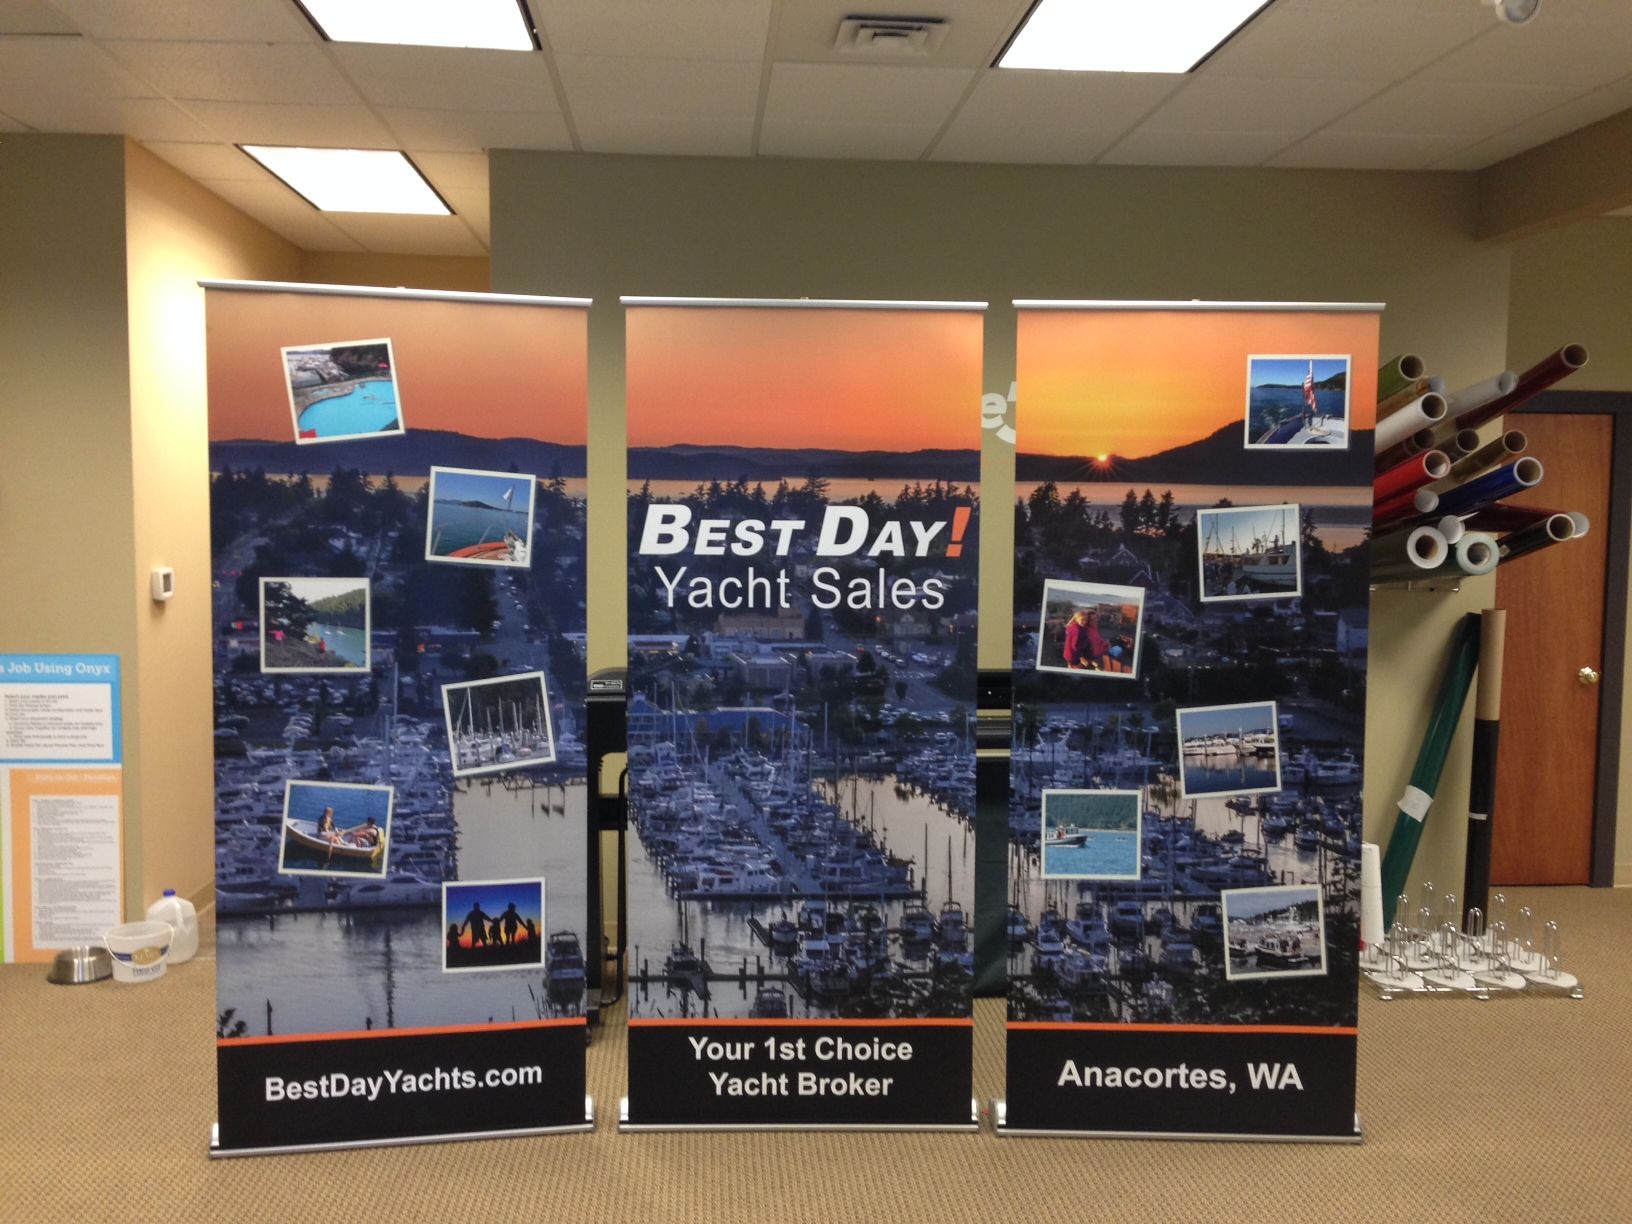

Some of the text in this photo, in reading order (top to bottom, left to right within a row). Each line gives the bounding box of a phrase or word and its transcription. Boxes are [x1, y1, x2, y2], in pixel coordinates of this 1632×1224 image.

[639, 504, 805, 556] BEST
[654, 566, 945, 609] Yacht Sales
[8, 662, 31, 673] Job
[35, 662, 72, 675] Using
[75, 662, 111, 675] Onyx
[688, 1036, 913, 1060] Your 1st Choice
[265, 1065, 543, 1101] BestDayYachts.com
[708, 1072, 893, 1096] Yacht Broker
[1057, 1059, 1304, 1094] Anacortes, WA
